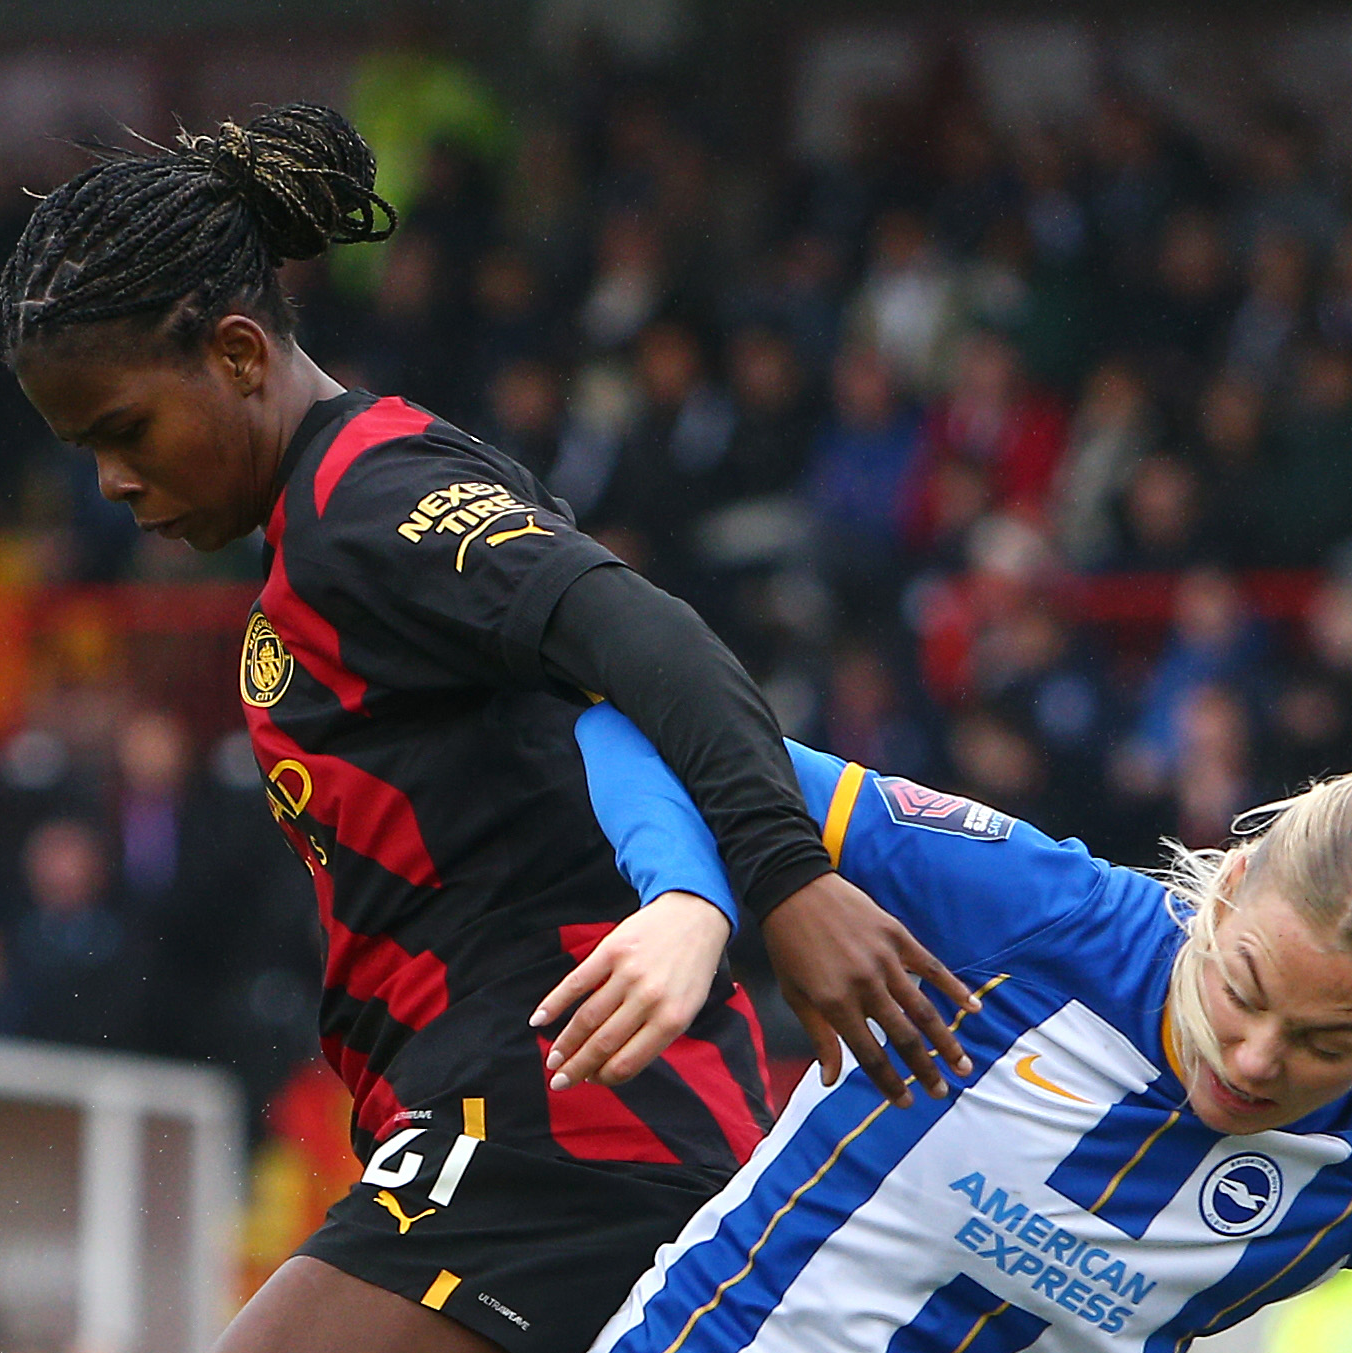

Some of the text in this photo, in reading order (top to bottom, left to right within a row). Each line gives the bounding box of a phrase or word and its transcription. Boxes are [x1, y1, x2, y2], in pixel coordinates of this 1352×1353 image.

[435, 494, 526, 535] TIRE
[255, 692, 275, 701] CITY
[949, 1171, 1158, 1305] AMERICAN
[954, 1217, 1135, 1334] EXPRESS
[478, 1292, 531, 1332] ULTRAWEAVE
